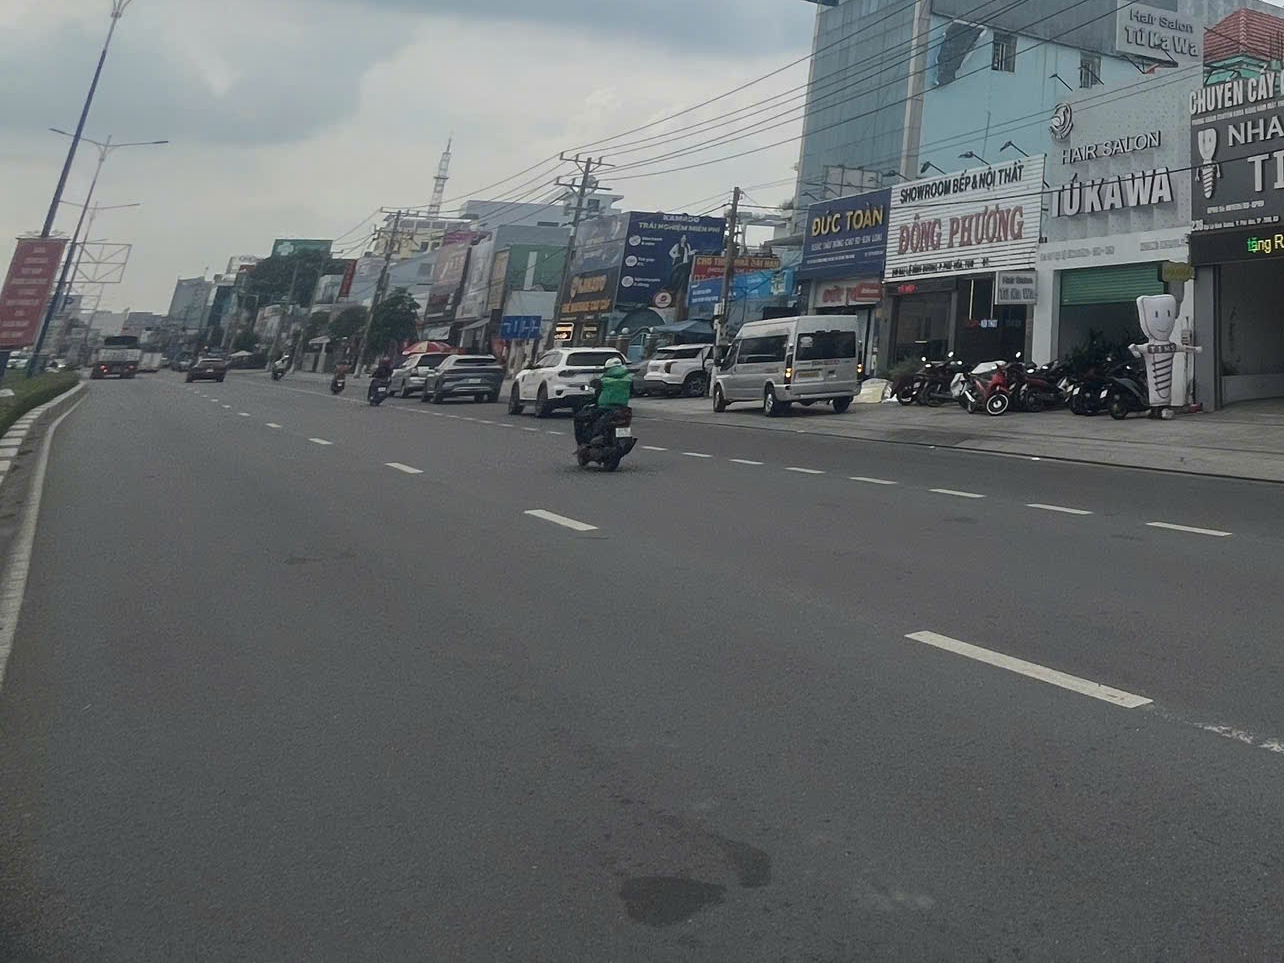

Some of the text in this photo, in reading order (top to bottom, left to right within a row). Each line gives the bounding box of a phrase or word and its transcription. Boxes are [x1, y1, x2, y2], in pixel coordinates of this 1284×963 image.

[1130, 9, 1194, 34] Hair Salon
[1189, 77, 1243, 115] CHUYÊN
[1062, 130, 1161, 165] HAIR SALON
[1228, 116, 1284, 147] NHA
[900, 178, 951, 204] SHOWROOM
[953, 169, 970, 193] BẾP
[972, 179, 978, 190] &
[979, 171, 996, 191] NỘI
[811, 202, 884, 237] ĐỨC TOÀN
[949, 205, 1024, 248] PHƯƠNG
